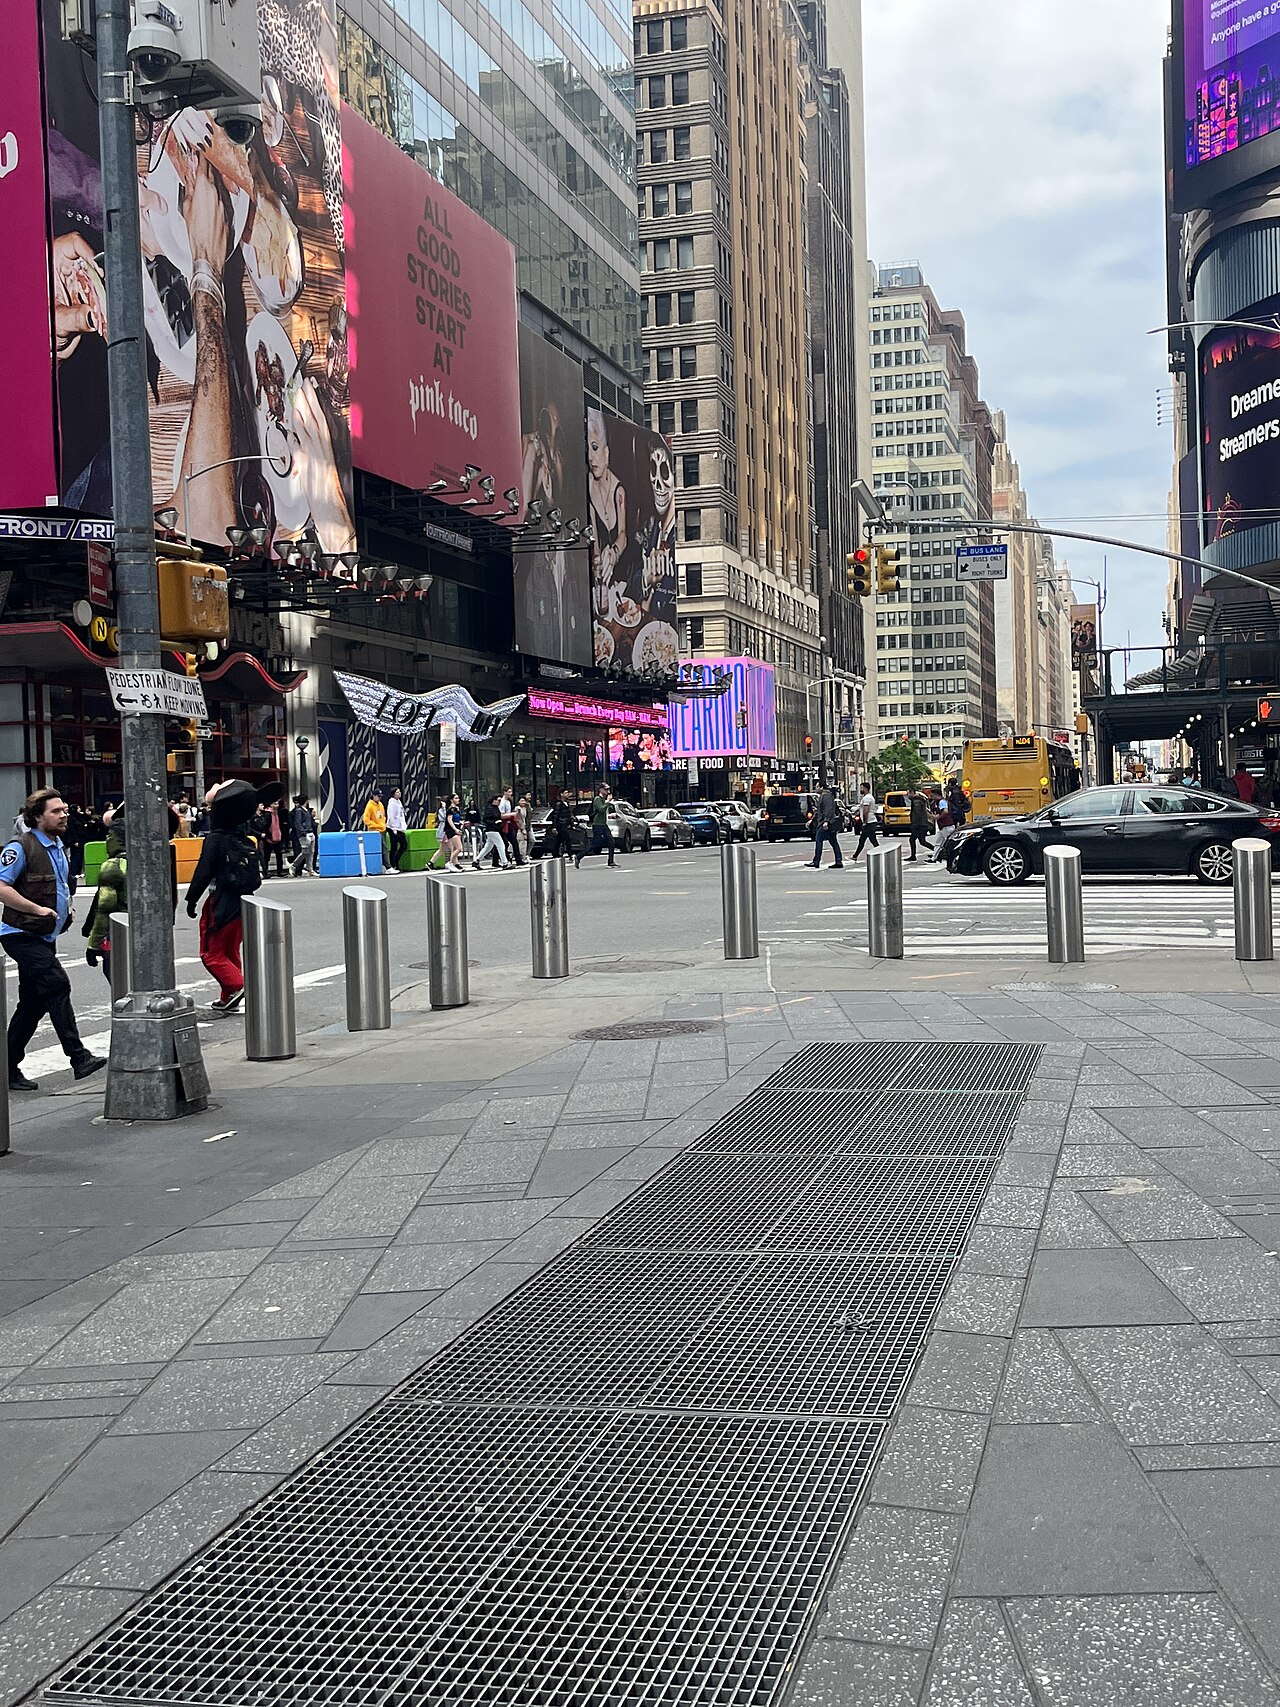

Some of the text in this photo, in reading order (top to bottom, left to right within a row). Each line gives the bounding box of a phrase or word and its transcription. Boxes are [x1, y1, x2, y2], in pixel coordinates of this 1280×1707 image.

[1210, 22, 1241, 44] Anyone
[1241, 10, 1262, 28] have
[1263, 6, 1269, 16] a
[424, 195, 453, 241] ALL
[417, 224, 461, 278] GOOD
[407, 252, 472, 320] STORIES
[415, 295, 466, 350] START
[432, 342, 454, 376] AT
[409, 374, 478, 441] pink taco
[1219, 419, 1280, 462] Streamers
[81, 523, 114, 539] PRI
[970, 546, 1004, 555] BUS LANE
[97, 620, 105, 638] N
[1221, 627, 1267, 644] FIVE
[109, 671, 202, 697] PEDESTRIAN FLOW ZONE
[163, 694, 206, 716] KEEP MOVING
[546, 698, 564, 713] Open
[574, 702, 598, 716] Brunch
[597, 705, 614, 721] Every
[614, 708, 625, 722] Day
[699, 757, 724, 770] FOOD
[1241, 748, 1264, 759] LOBSTE
